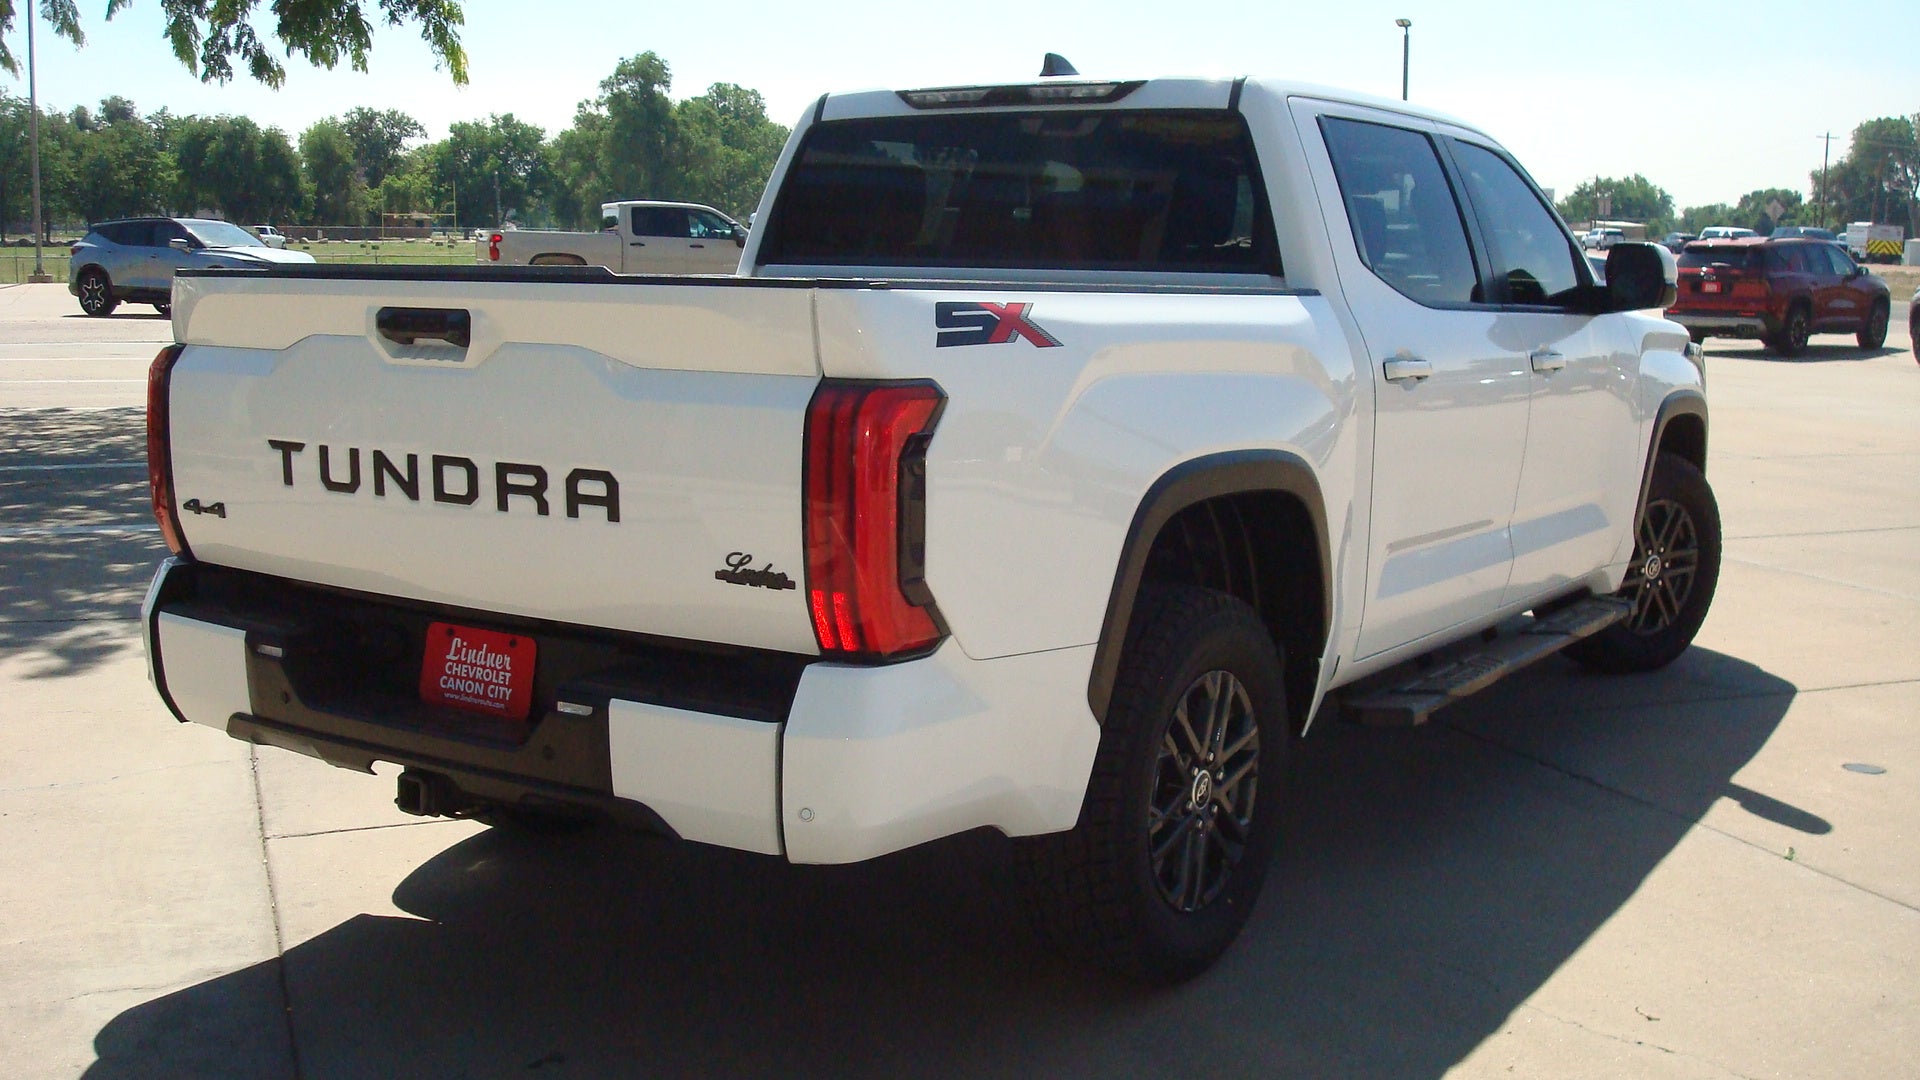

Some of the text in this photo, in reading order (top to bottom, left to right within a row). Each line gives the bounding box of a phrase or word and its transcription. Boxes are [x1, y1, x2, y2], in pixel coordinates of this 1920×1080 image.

[268, 439, 620, 522] TUNDRA
[445, 637, 511, 671] Lindner
[440, 675, 513, 701] CANON CITY
[445, 661, 512, 686] CHEVROLET
